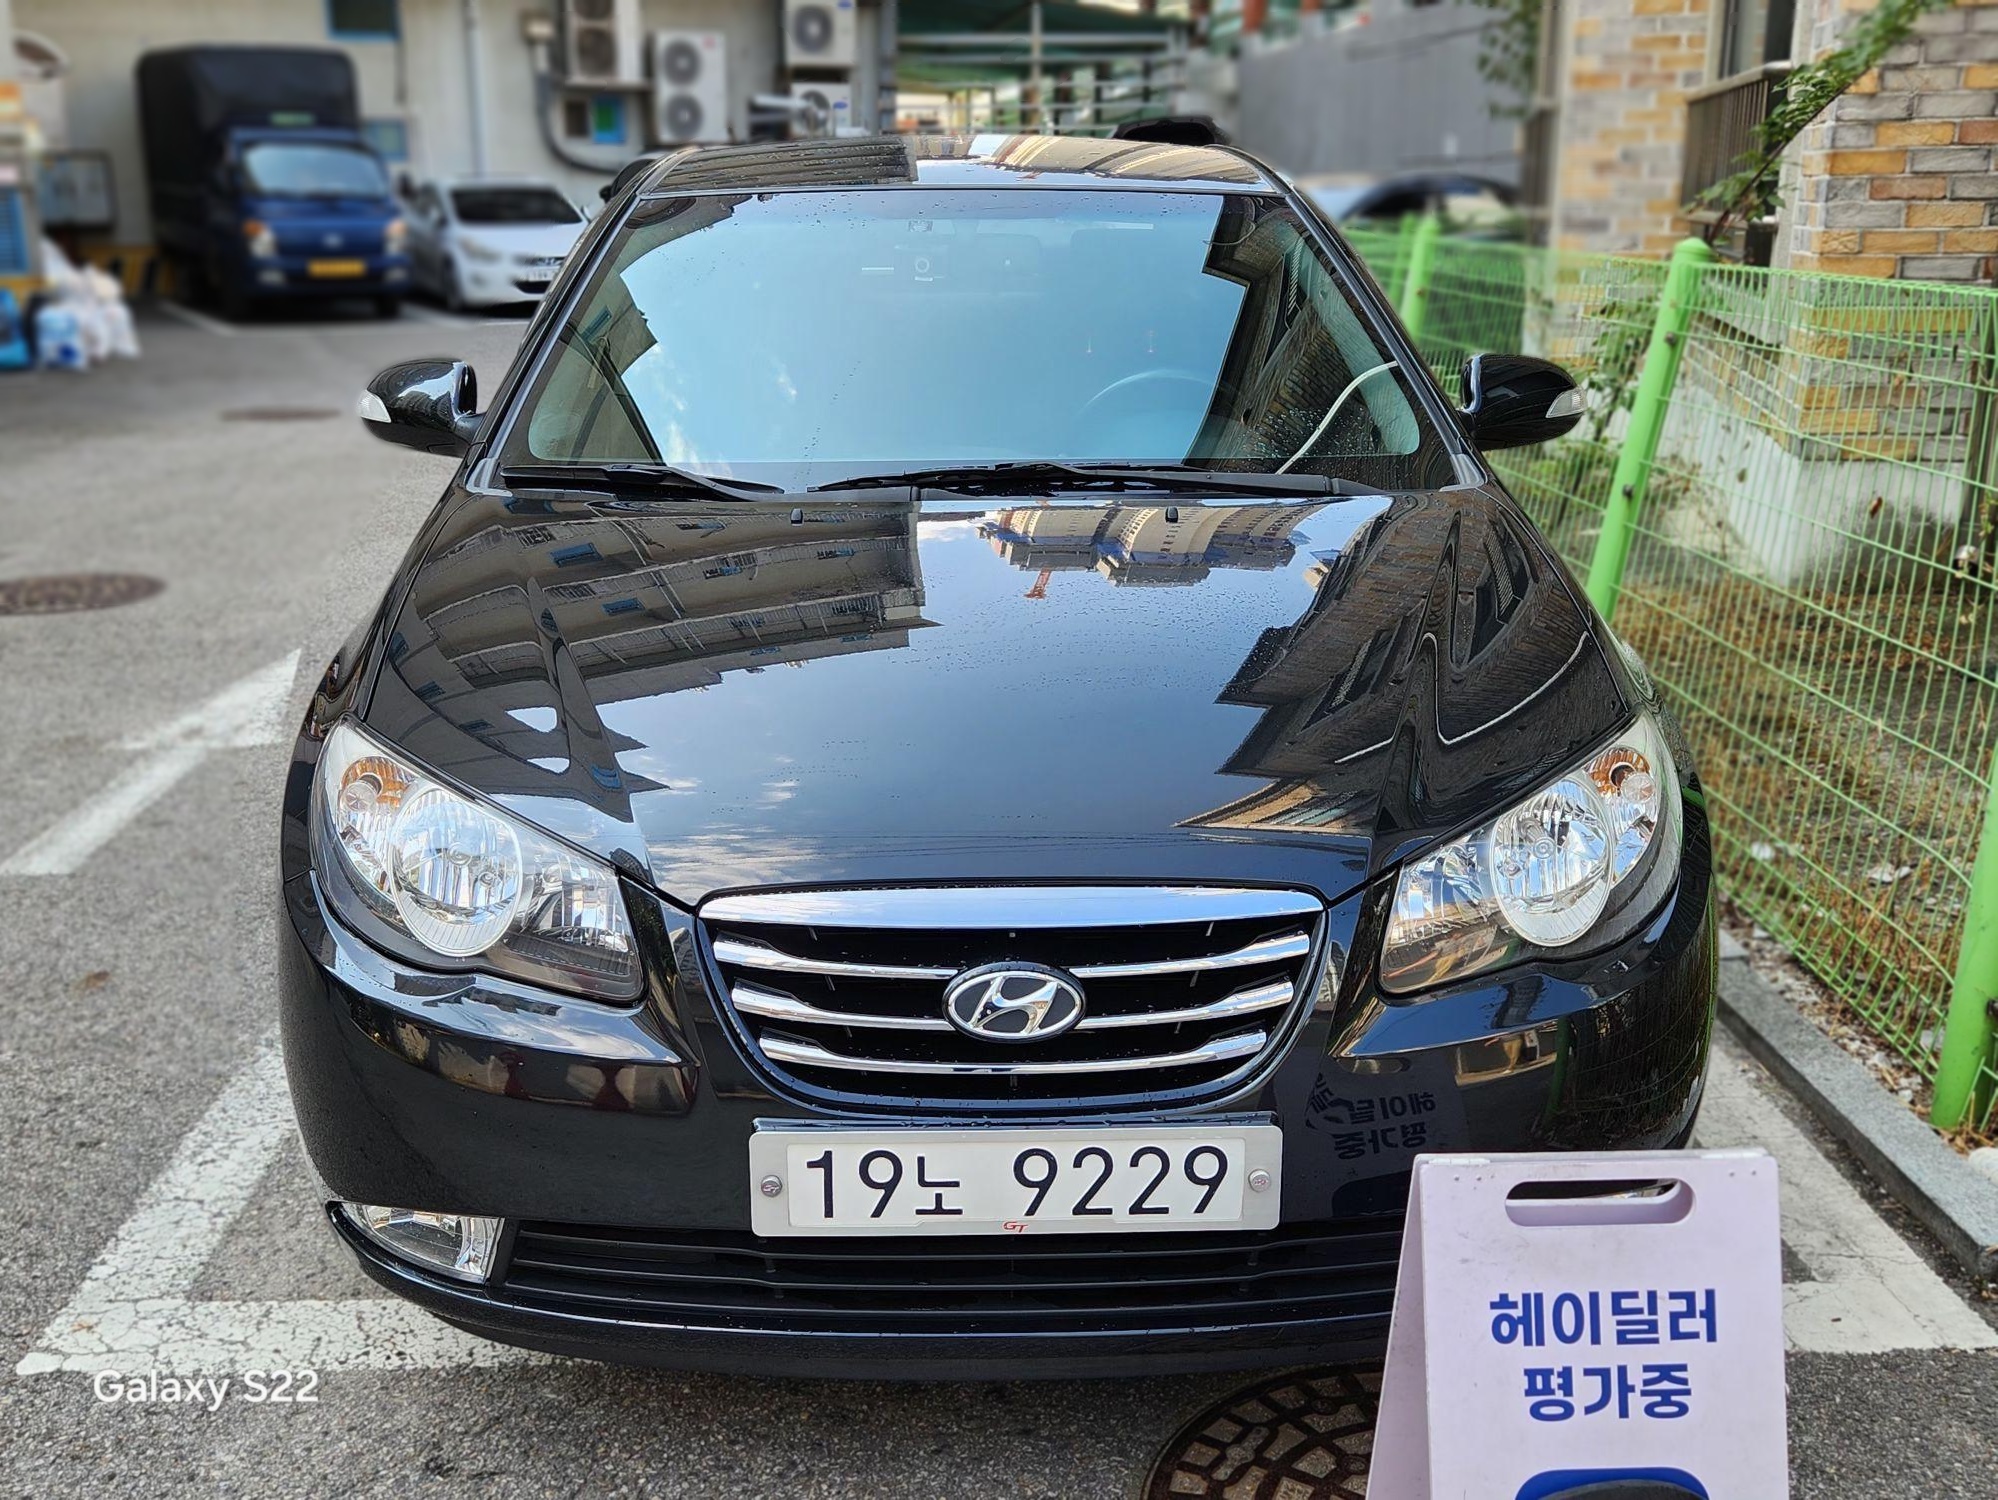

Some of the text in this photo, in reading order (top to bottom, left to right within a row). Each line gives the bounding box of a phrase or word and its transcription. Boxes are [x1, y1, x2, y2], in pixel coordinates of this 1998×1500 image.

[806, 1145, 1229, 1219] 19노 9229
[1002, 1221, 1029, 1233] GT
[1489, 1288, 1718, 1347] 헤이딜러
[1523, 1363, 1692, 1422] 평가중
